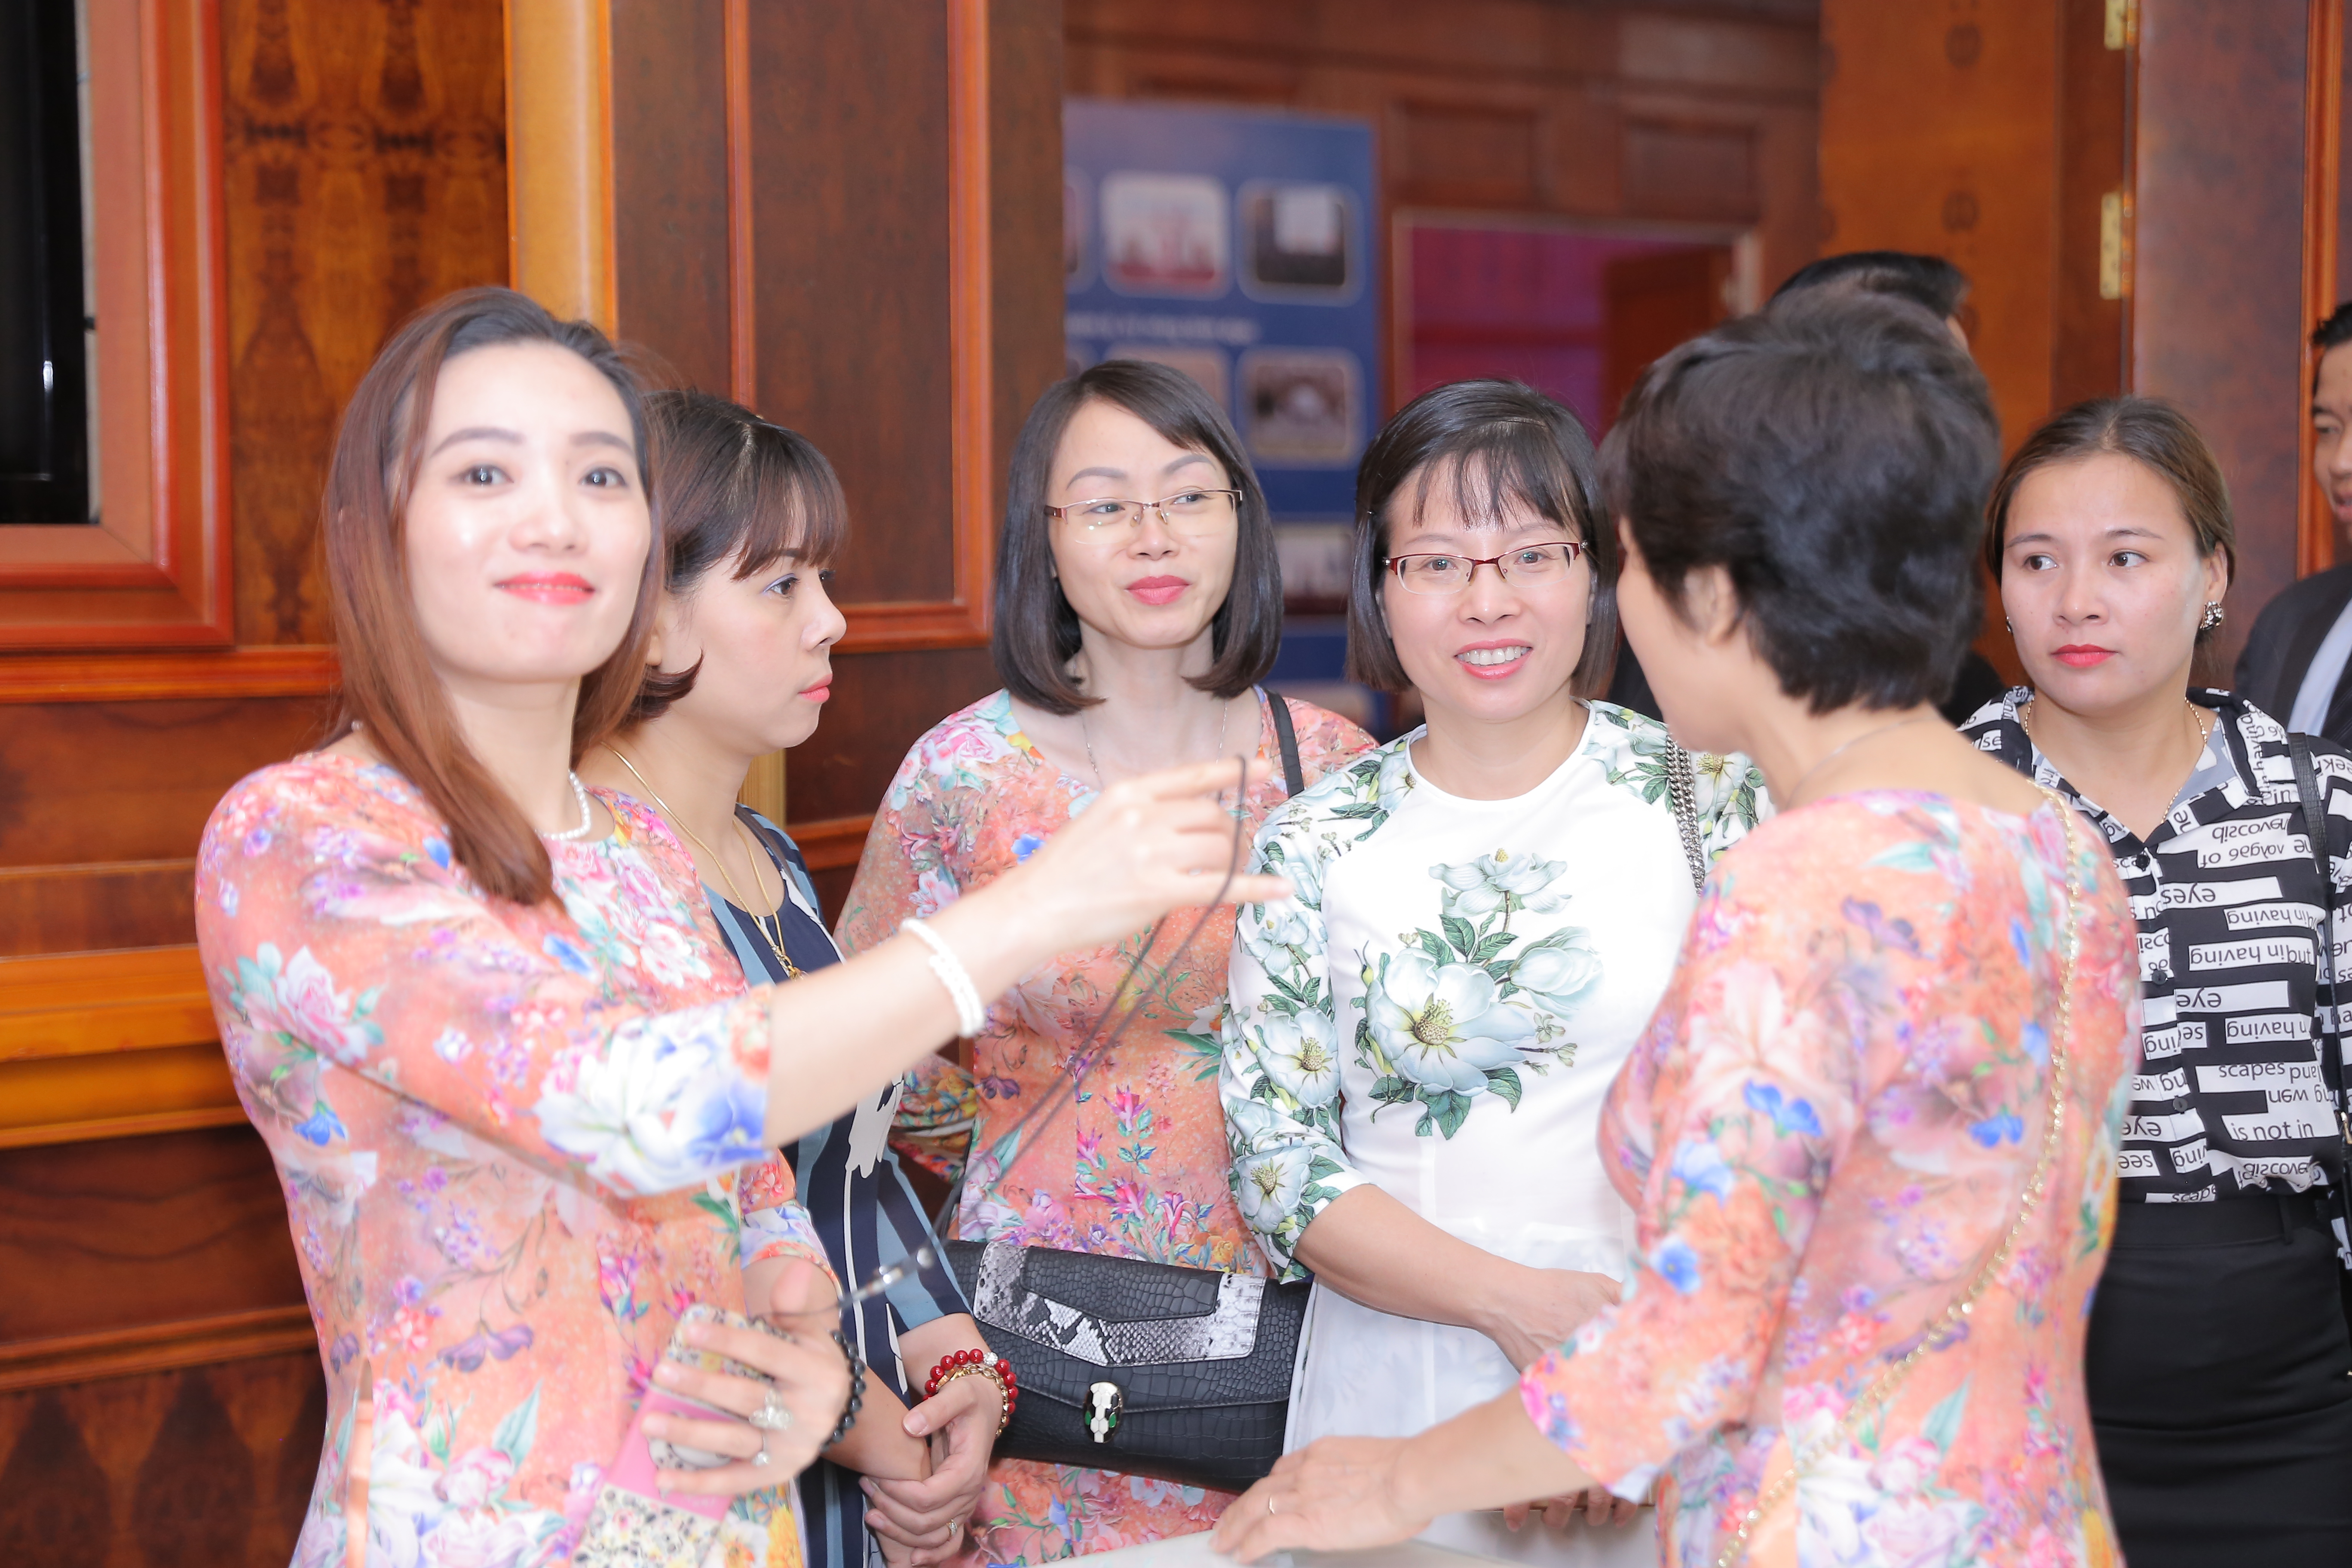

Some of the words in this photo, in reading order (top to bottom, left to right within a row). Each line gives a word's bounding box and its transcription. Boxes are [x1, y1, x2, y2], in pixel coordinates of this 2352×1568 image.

[2161, 882, 2215, 903] eyes
[2227, 910, 2292, 925] having
[2190, 947, 2261, 966] having
[2227, 1021, 2295, 1039] having
[2218, 1062, 2285, 1080] scapes
[2230, 1122, 2248, 1141] is
[2253, 1121, 2292, 1140] not
[2296, 1118, 2315, 1138] in
